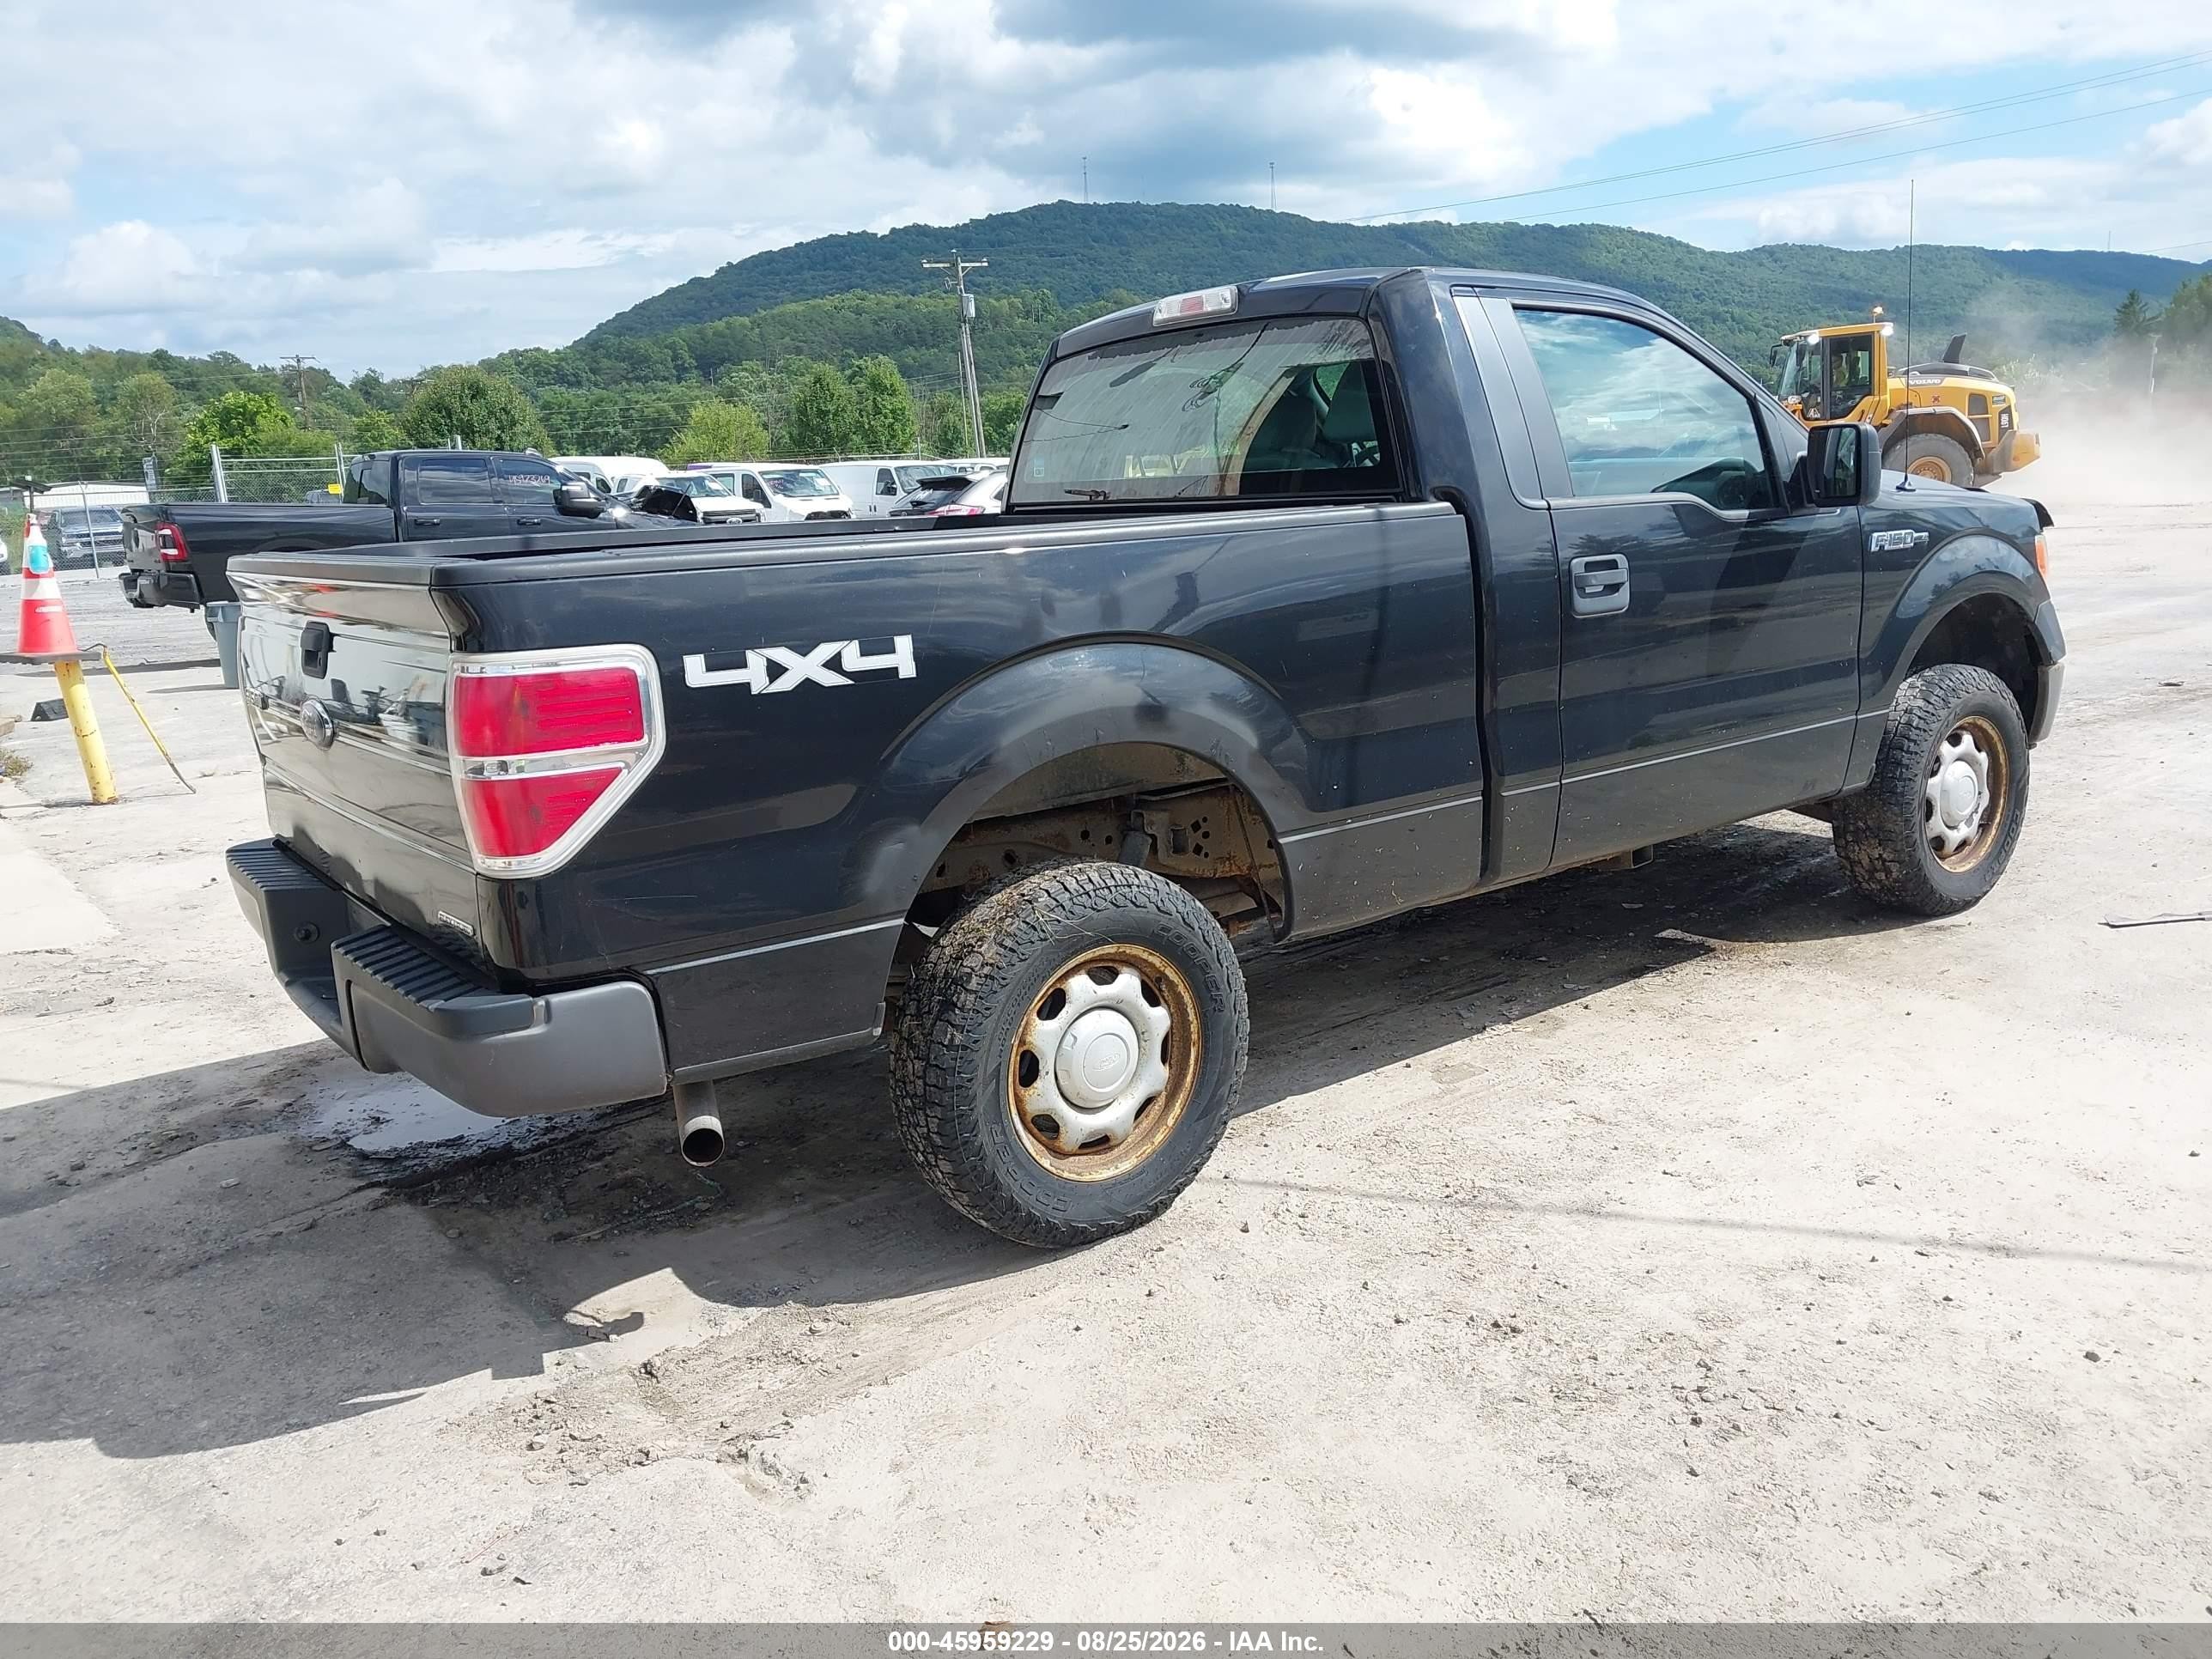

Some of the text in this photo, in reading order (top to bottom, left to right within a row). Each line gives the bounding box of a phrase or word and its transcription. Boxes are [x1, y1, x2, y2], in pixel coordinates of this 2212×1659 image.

[1870, 529, 1916, 552] F-150
[683, 634, 917, 696] 4X4
[1154, 921, 1224, 1012] COOPER
